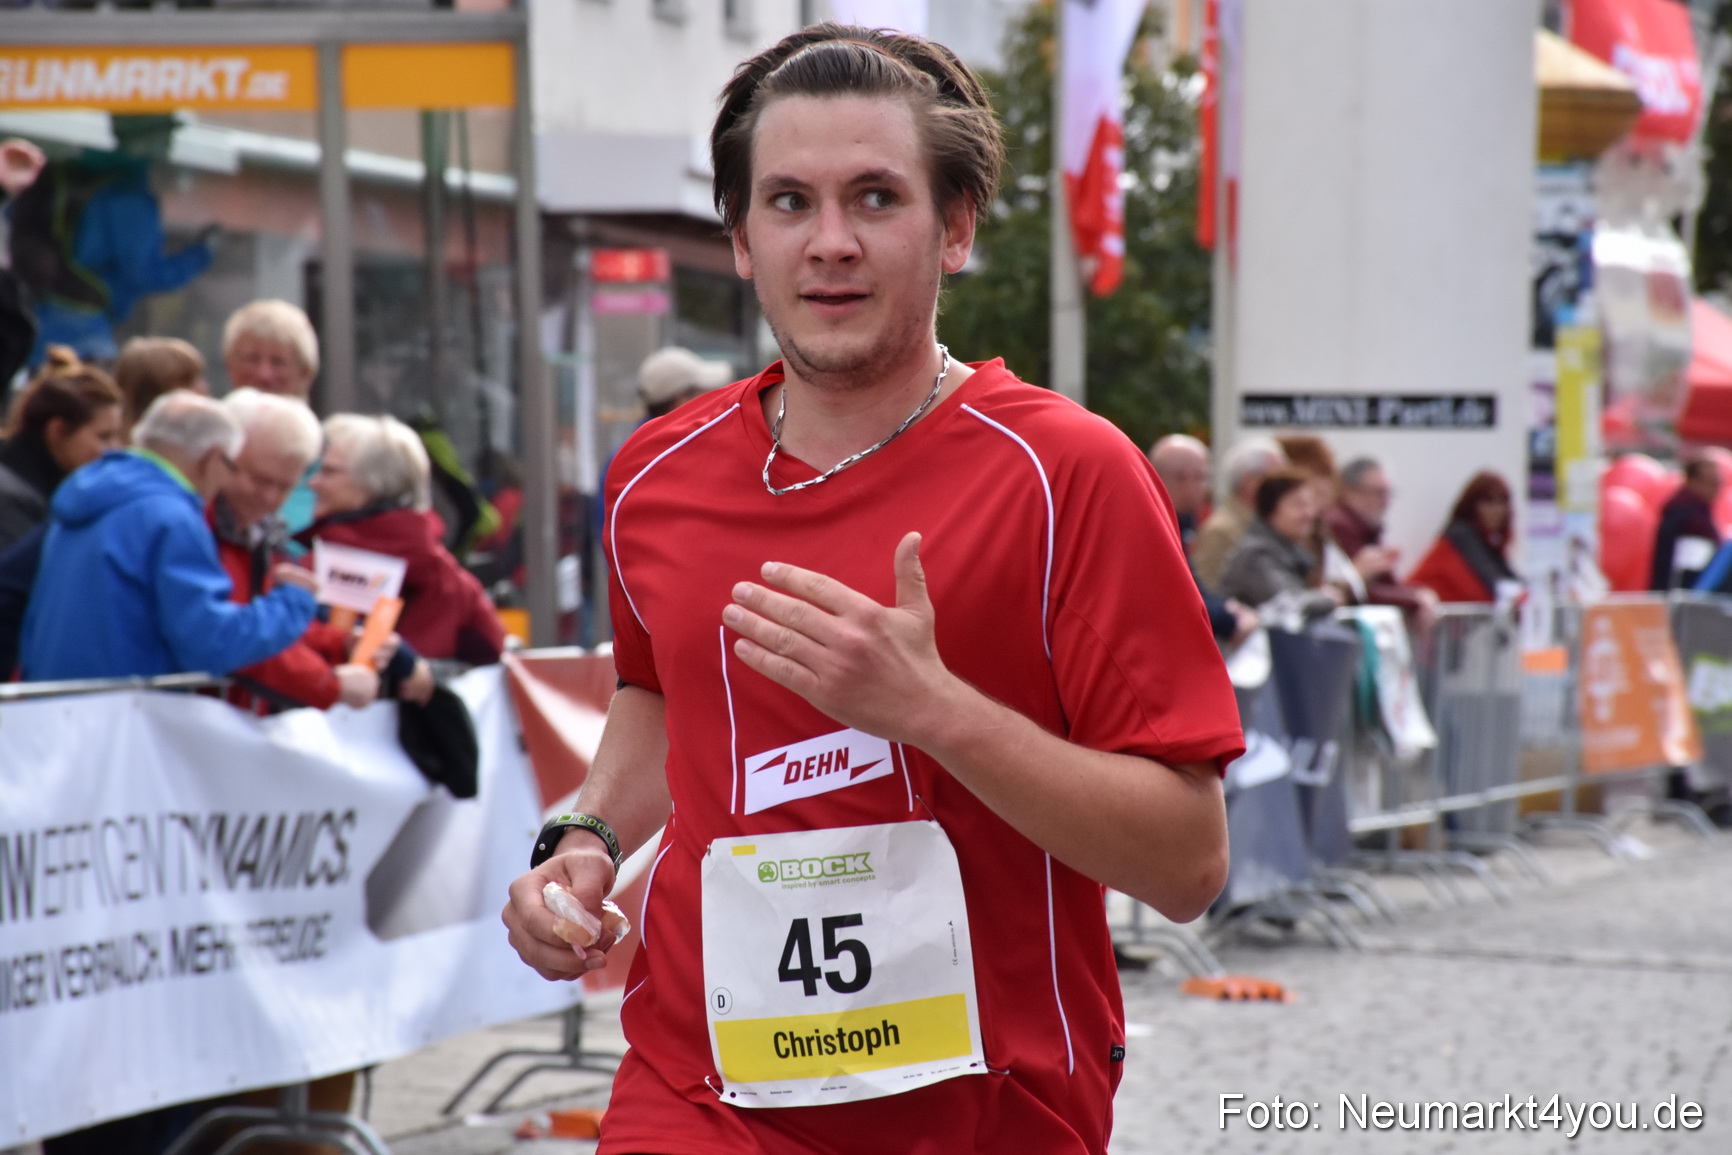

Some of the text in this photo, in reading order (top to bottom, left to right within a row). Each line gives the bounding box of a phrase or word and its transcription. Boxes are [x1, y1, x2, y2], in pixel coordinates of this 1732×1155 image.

[783, 747, 849, 785] DEHN
[780, 852, 873, 881] BOCK
[781, 881, 807, 889] inspired
[808, 880, 817, 888] by
[842, 874, 876, 883] concepts
[778, 913, 872, 996] 45
[717, 994, 726, 1009] D
[773, 1019, 900, 1059] Christoph
